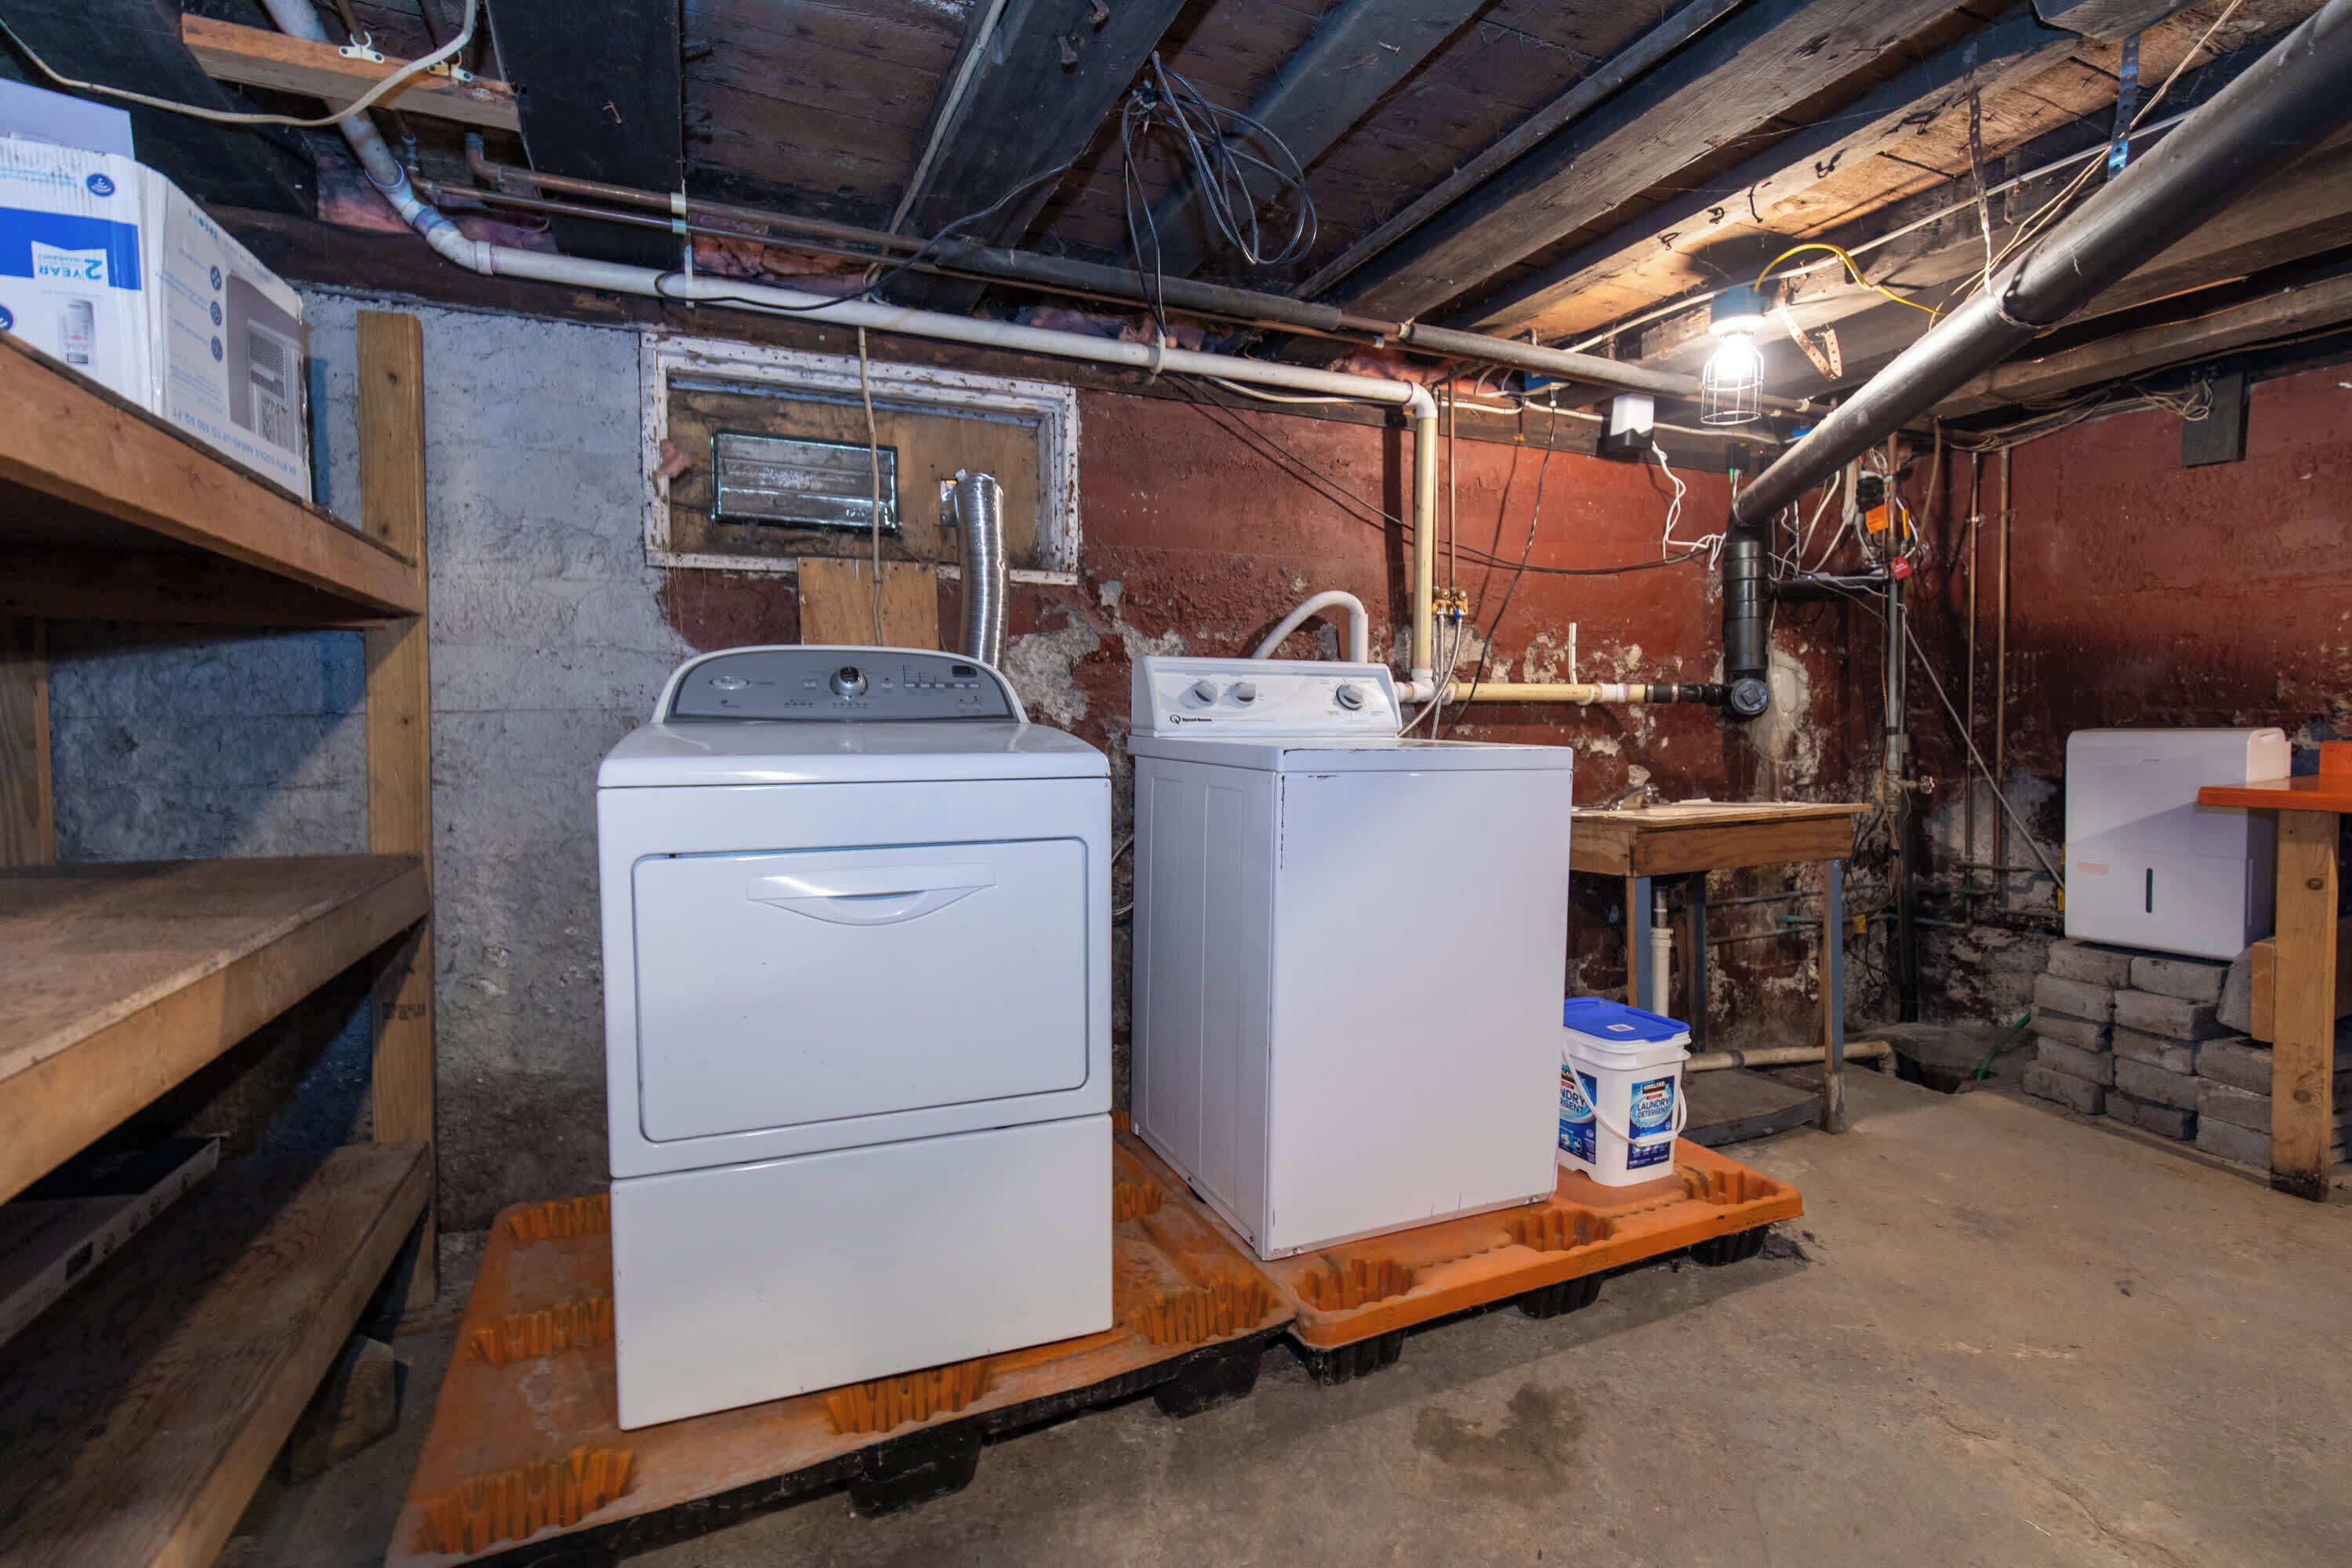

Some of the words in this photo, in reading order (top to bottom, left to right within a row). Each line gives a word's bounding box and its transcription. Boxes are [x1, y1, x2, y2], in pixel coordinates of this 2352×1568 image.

[39, 264, 83, 279] YEAR
[84, 259, 103, 281] 2
[212, 426, 221, 440] TO
[1643, 1080, 1665, 1091] KIRKLAND
[1560, 1089, 1585, 1104] NDRY
[1560, 1097, 1584, 1114] RGENT
[1637, 1098, 1669, 1111] LAUNDRY
[1638, 1107, 1668, 1118] DETERGENT
